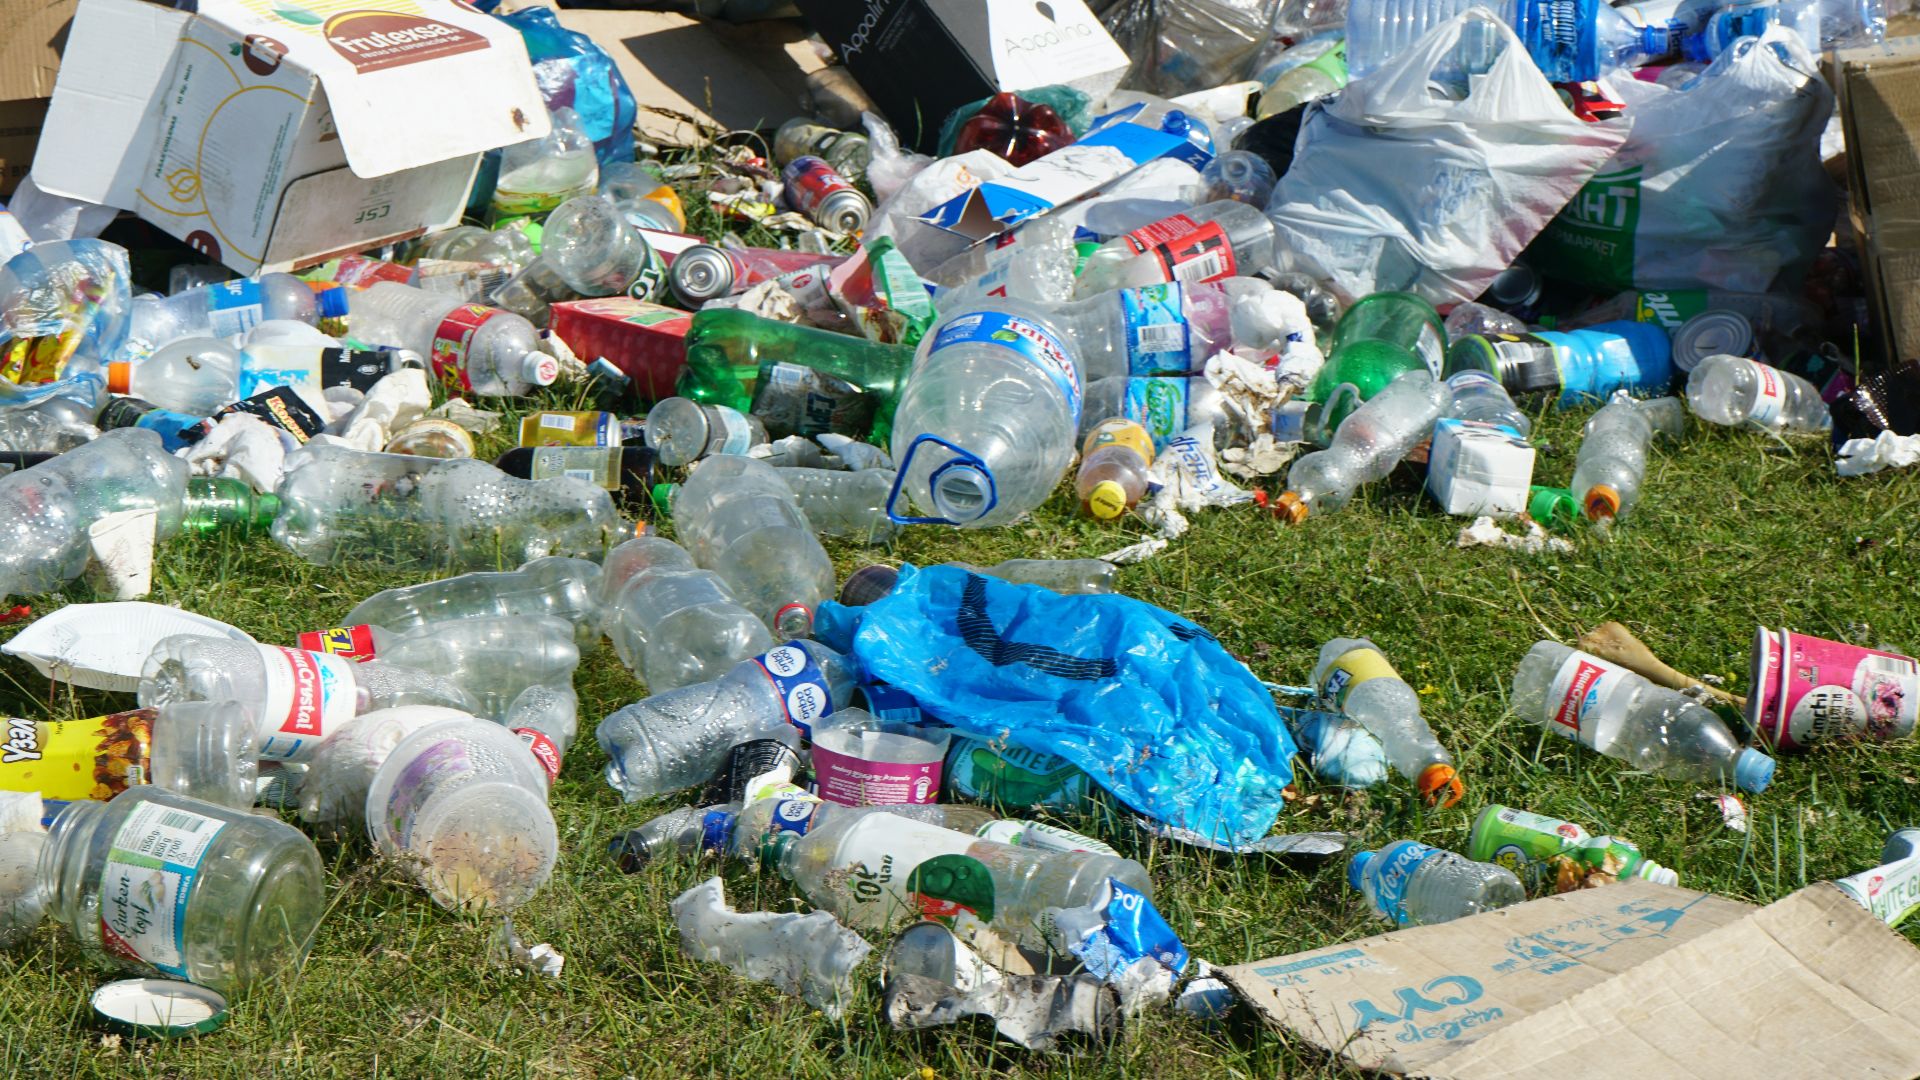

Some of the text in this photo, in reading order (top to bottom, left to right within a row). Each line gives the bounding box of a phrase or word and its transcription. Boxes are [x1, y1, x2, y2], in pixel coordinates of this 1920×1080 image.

[329, 22, 449, 54] Frutexsa
[837, 0, 891, 64] Appalin
[1004, 21, 1092, 57] Appalina
[354, 205, 390, 225] CSF
[1566, 185, 1637, 228] АНТ
[1562, 665, 1598, 725] AquaCrystal
[178, 875, 193, 905] EDEKA
